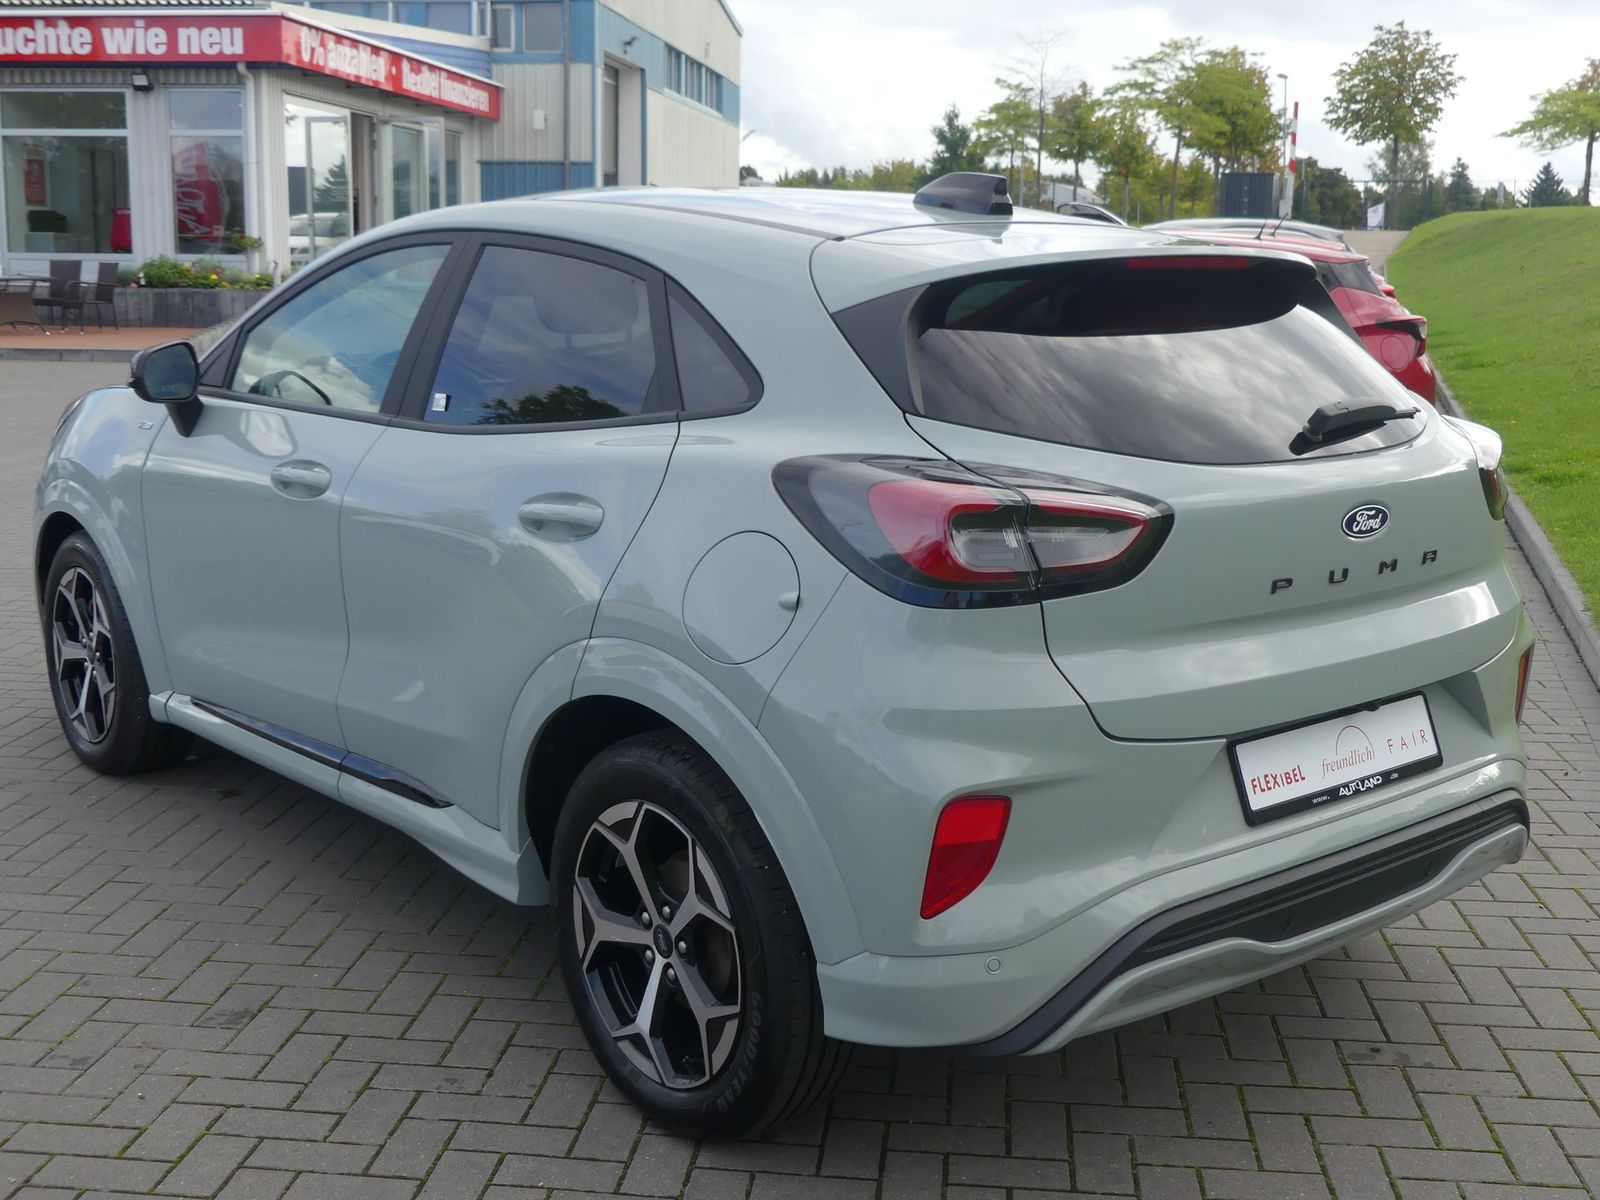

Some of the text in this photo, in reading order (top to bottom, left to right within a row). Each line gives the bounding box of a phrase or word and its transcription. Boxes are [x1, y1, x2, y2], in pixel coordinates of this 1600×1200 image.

[101, 19, 167, 55] wie
[177, 26, 243, 55] neu
[300, 26, 325, 66] 0%
[328, 40, 385, 82] anzahlen
[1352, 509, 1382, 533] Ford
[1270, 549, 1438, 595] PUMA
[1250, 728, 1429, 795] FLEXIBEL freundlich FAIR
[1311, 795, 1330, 804] www.
